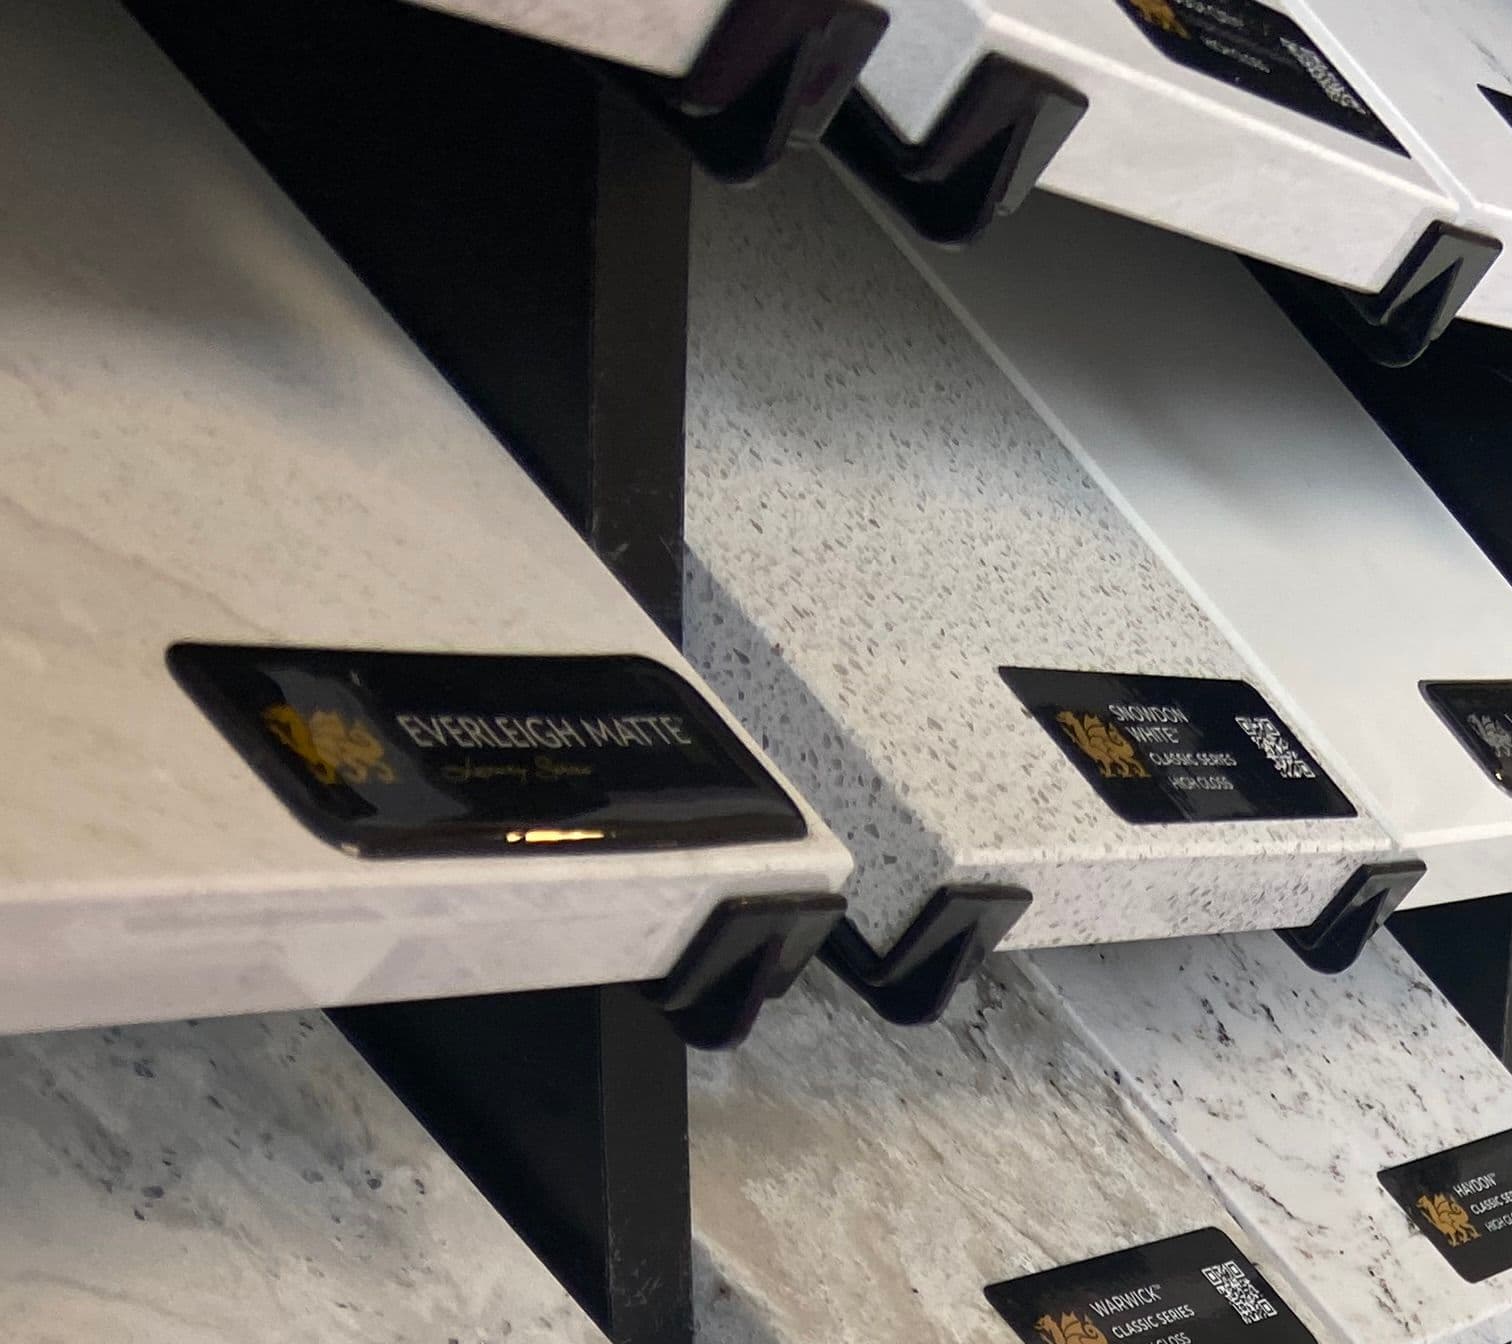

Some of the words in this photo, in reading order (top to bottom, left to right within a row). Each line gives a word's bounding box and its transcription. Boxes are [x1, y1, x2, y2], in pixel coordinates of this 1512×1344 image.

[1109, 705, 1188, 724] SNOWDON
[397, 713, 587, 749] EVERLEIGH
[590, 716, 691, 746] MATTE
[1470, 1196, 1502, 1215] CLASSIC
[1484, 1217, 1505, 1233] HIGH
[1111, 1315, 1157, 1340] CLASSIC
[1156, 1304, 1195, 1329] SERIES
